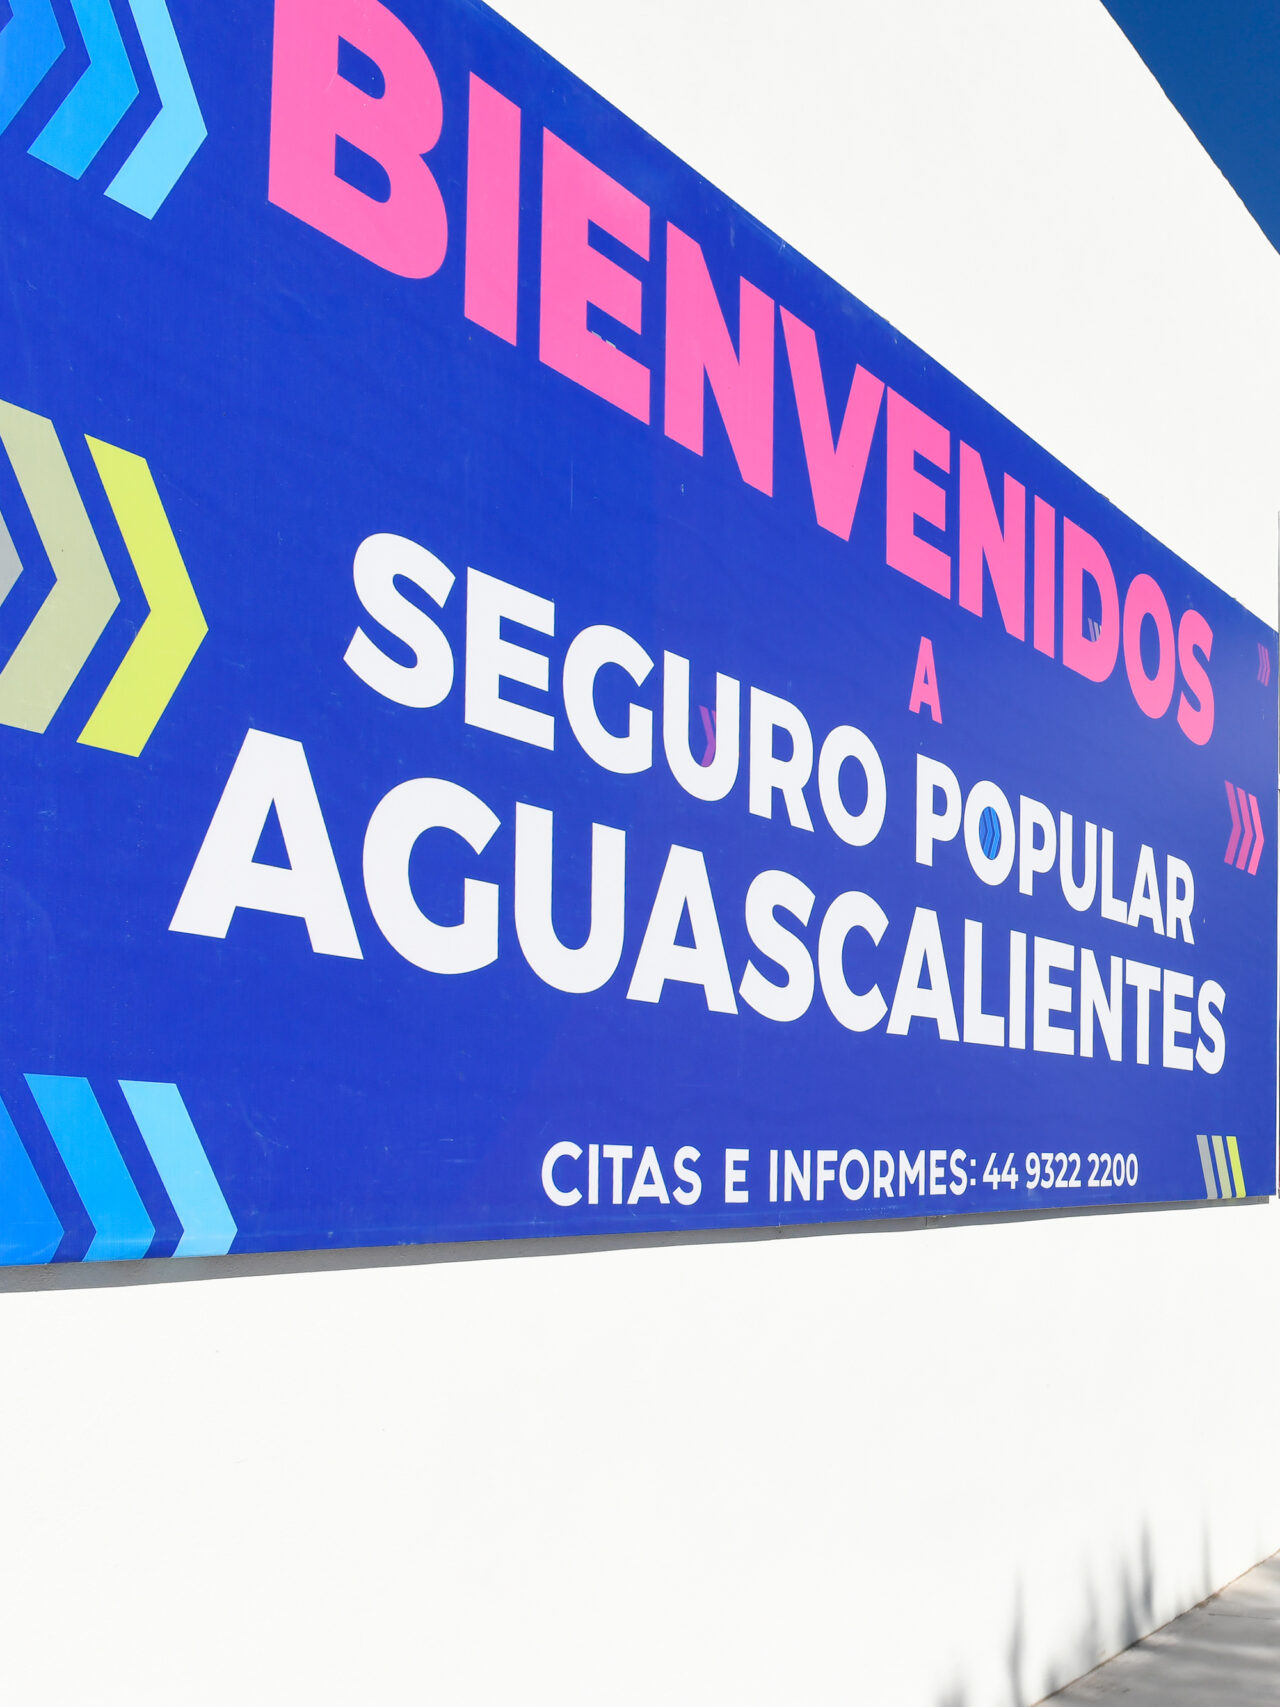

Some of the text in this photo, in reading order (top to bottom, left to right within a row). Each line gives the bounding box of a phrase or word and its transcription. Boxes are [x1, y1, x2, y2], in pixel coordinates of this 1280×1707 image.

[268, 0, 1215, 746] BIENVENIDOS
[343, 533, 1195, 945] SEGURO POPULAR
[908, 636, 943, 724] A
[168, 728, 1226, 1075] AGUASCALIENTES
[541, 1141, 1139, 1206] CITAS E INFORMES: 44 9322 2200
